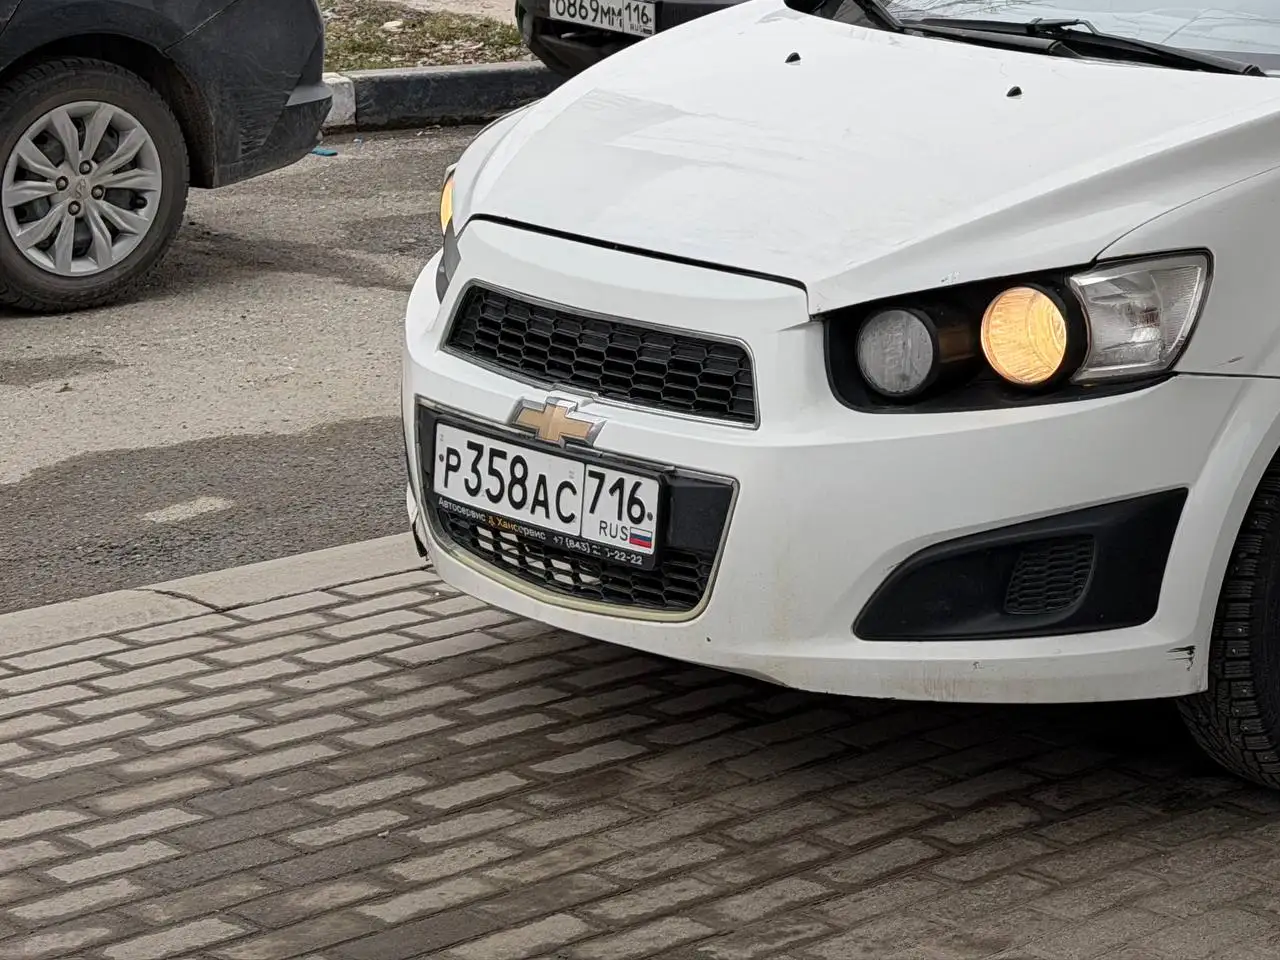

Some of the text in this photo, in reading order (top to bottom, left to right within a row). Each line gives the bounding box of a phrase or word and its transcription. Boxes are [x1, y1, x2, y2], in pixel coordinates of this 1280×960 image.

[625, 2, 649, 25] 116
[438, 497, 486, 522] Автосервис
[587, 469, 646, 525] 716
[599, 520, 629, 541] RUS
[565, 537, 591, 554] (843)
[591, 545, 643, 565] 2-22-22
